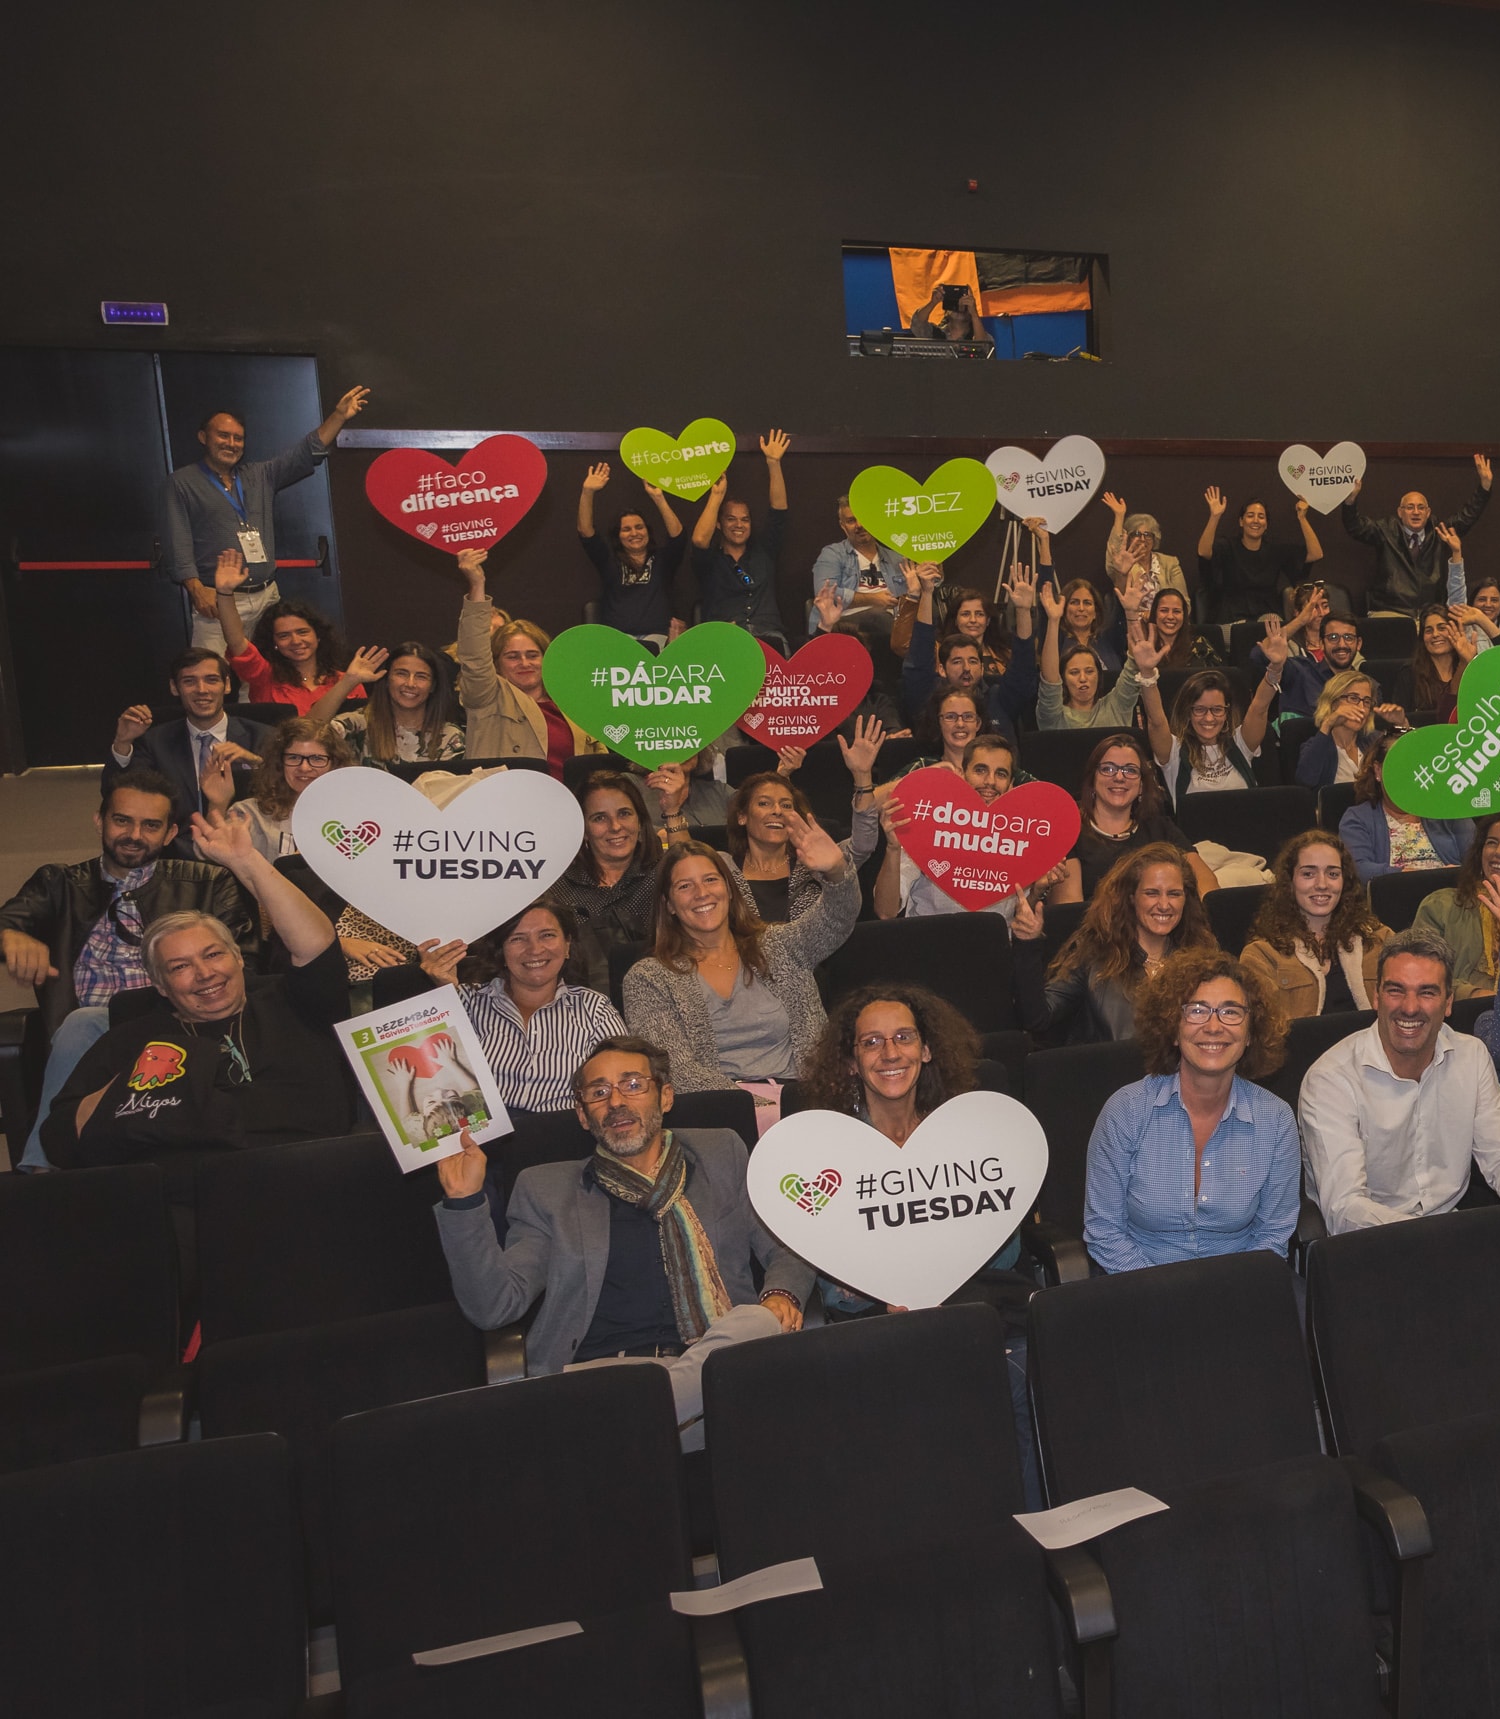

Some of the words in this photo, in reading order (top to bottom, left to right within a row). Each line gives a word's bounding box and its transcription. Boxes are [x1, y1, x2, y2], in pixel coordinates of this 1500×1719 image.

[631, 441, 730, 466] #façoparte
[675, 473, 708, 483] #GIVING
[1025, 465, 1086, 485] #GIVING
[1309, 465, 1352, 476] #GIVING
[418, 470, 486, 492] #faço
[676, 480, 711, 490] TUESDAY
[1027, 479, 1091, 498] TUESDAY
[1309, 476, 1355, 486] TUESDAY
[401, 484, 519, 513] diferença
[885, 492, 963, 518] #3DEZ
[442, 518, 494, 532] #GIVING
[442, 528, 498, 543] TUESDAY
[912, 532, 954, 542] #GIVING
[912, 540, 957, 552] TUESDAY
[591, 661, 726, 686] #DÁPARA
[763, 672, 846, 686] GANIZAÇÃO
[612, 685, 712, 707] MUDAR
[749, 696, 838, 708] MPORTANTE
[768, 715, 817, 726] #GIVING
[634, 726, 698, 738] #GIVING
[768, 726, 820, 736] TUESDAY
[635, 738, 702, 751] TUESDAY
[913, 799, 1050, 836] #doupara
[393, 830, 536, 852] #GIVING
[933, 830, 1030, 857] mudar
[393, 858, 546, 880] TUESDAY
[953, 866, 1008, 882] #GIVING
[952, 878, 1011, 893] TUESDAY
[361, 1032, 369, 1044] 3
[376, 1006, 438, 1034] DEZEMBRO
[115, 1092, 182, 1118] Migos
[856, 1158, 1003, 1200] #GIVING
[858, 1186, 1016, 1230] TUESDAY
